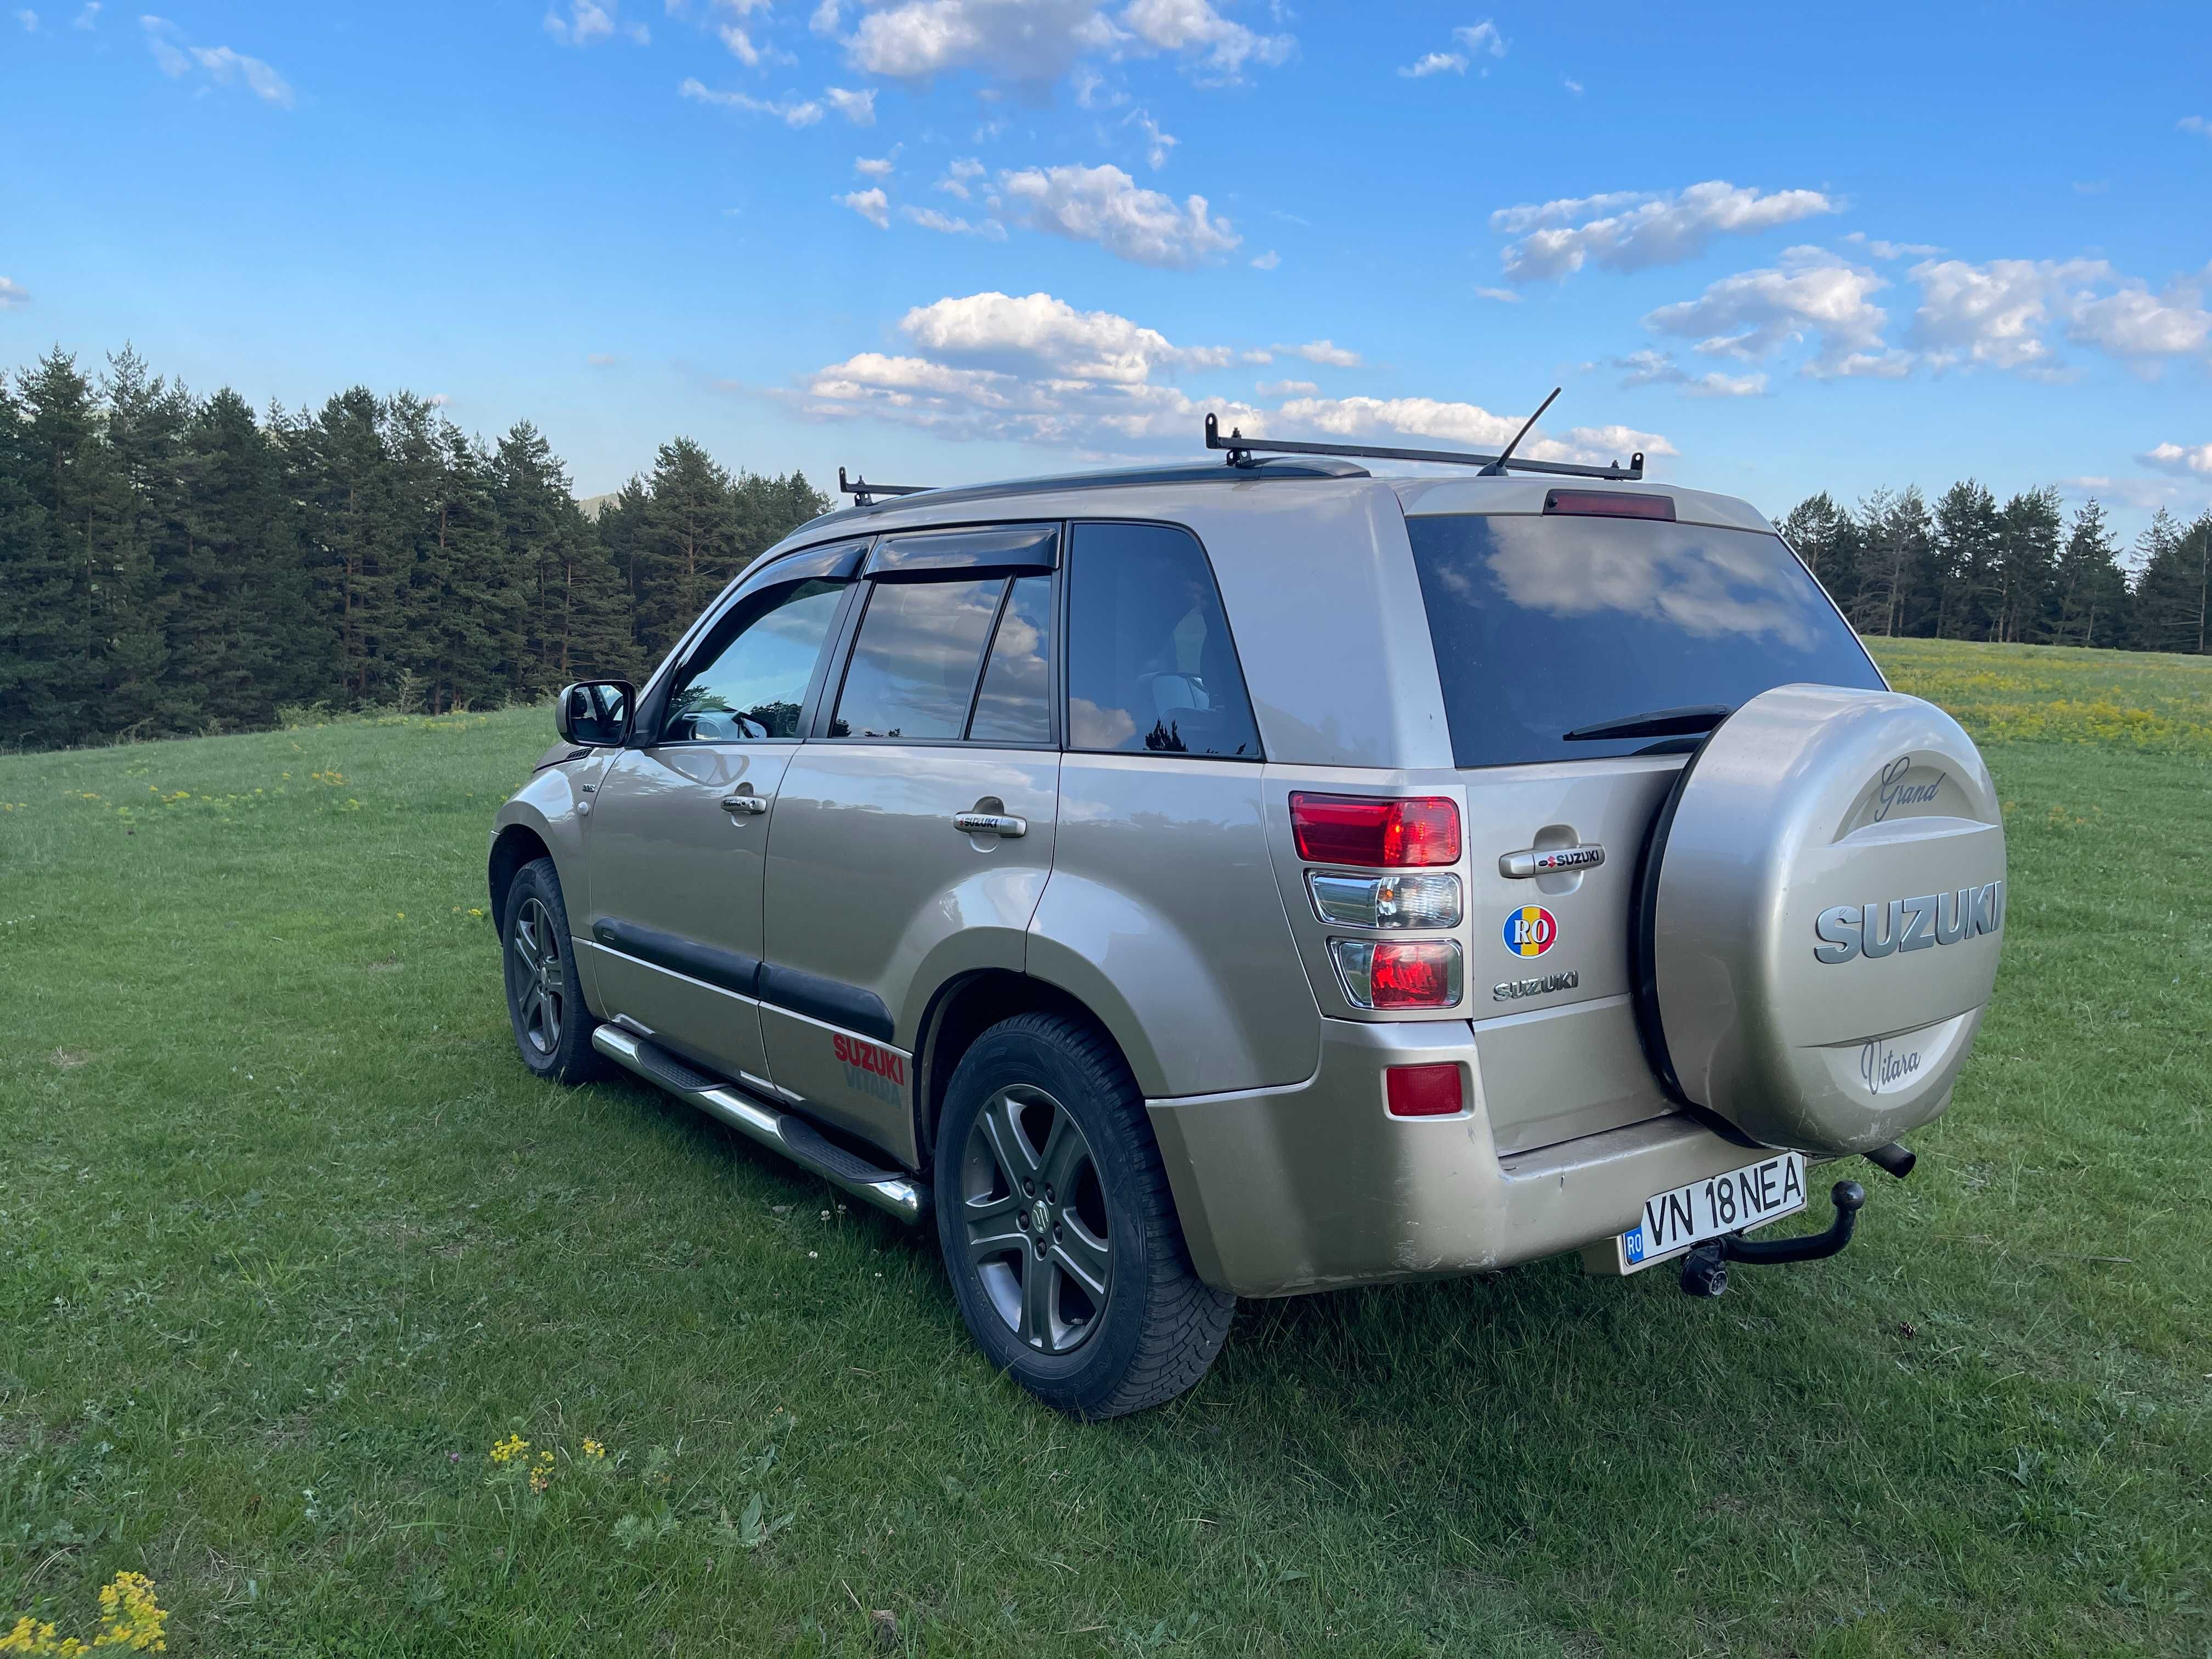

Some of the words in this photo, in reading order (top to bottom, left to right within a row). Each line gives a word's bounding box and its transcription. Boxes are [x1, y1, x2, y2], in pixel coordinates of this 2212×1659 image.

[1874, 756, 1946, 822] Grand
[964, 817, 998, 828] SUZUKI
[1556, 850, 1599, 867] SUZUKI
[1513, 918, 1550, 945] RO
[1813, 880, 2002, 964] SUZUKI
[1492, 970, 1579, 1002] SUZUKI
[833, 1033, 905, 1086] SUZUKI
[1861, 1037, 1921, 1095] Vitara
[843, 1062, 904, 1110] VITARA
[1646, 1189, 1694, 1246] VN
[1706, 1177, 1736, 1229] 18
[1739, 1156, 1802, 1218] NEA
[1627, 1233, 1643, 1257] RO
